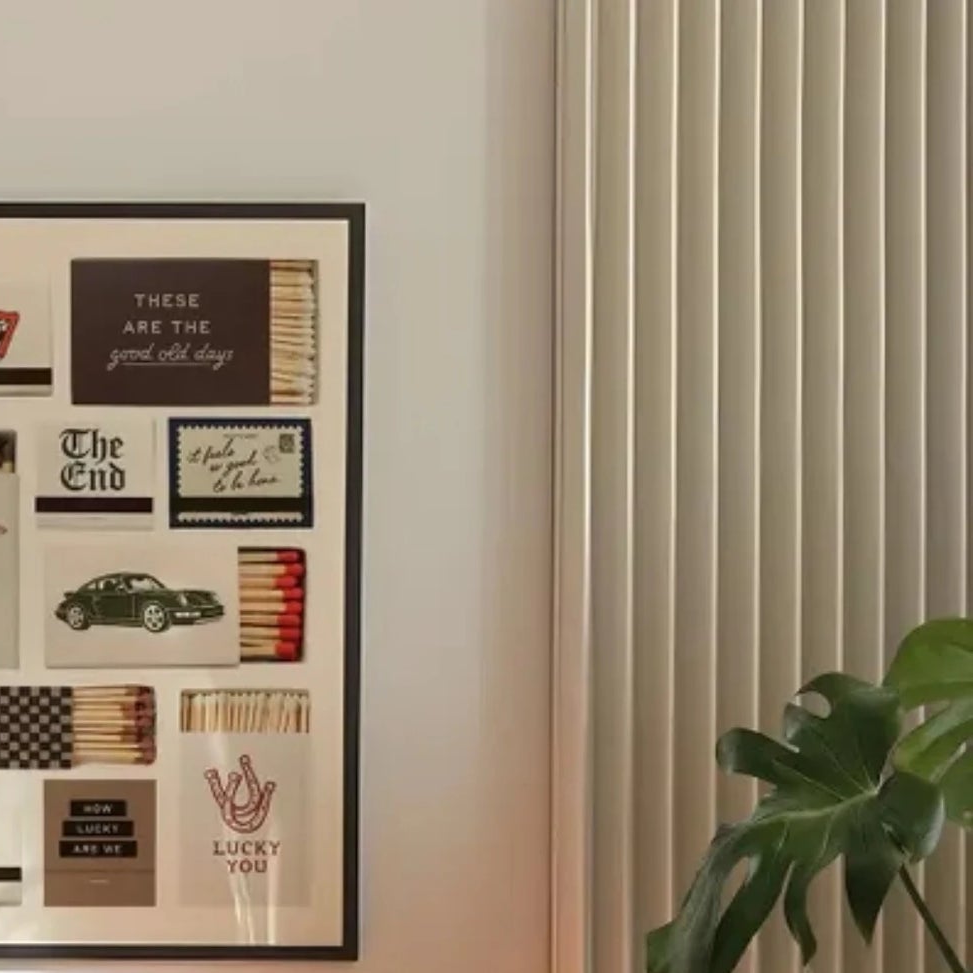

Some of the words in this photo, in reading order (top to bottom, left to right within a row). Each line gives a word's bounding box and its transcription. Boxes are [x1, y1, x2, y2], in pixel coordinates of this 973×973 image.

[133, 293, 200, 308] THESE
[122, 320, 162, 335] ARE
[171, 320, 211, 335] THE
[106, 342, 155, 371] good
[158, 342, 191, 361] old
[193, 342, 234, 371] days
[58, 428, 125, 465] The
[60, 461, 125, 491] End
[75, 823, 119, 835] LUCKY
[212, 840, 280, 856] LUCKY
[227, 859, 268, 873] YOU
